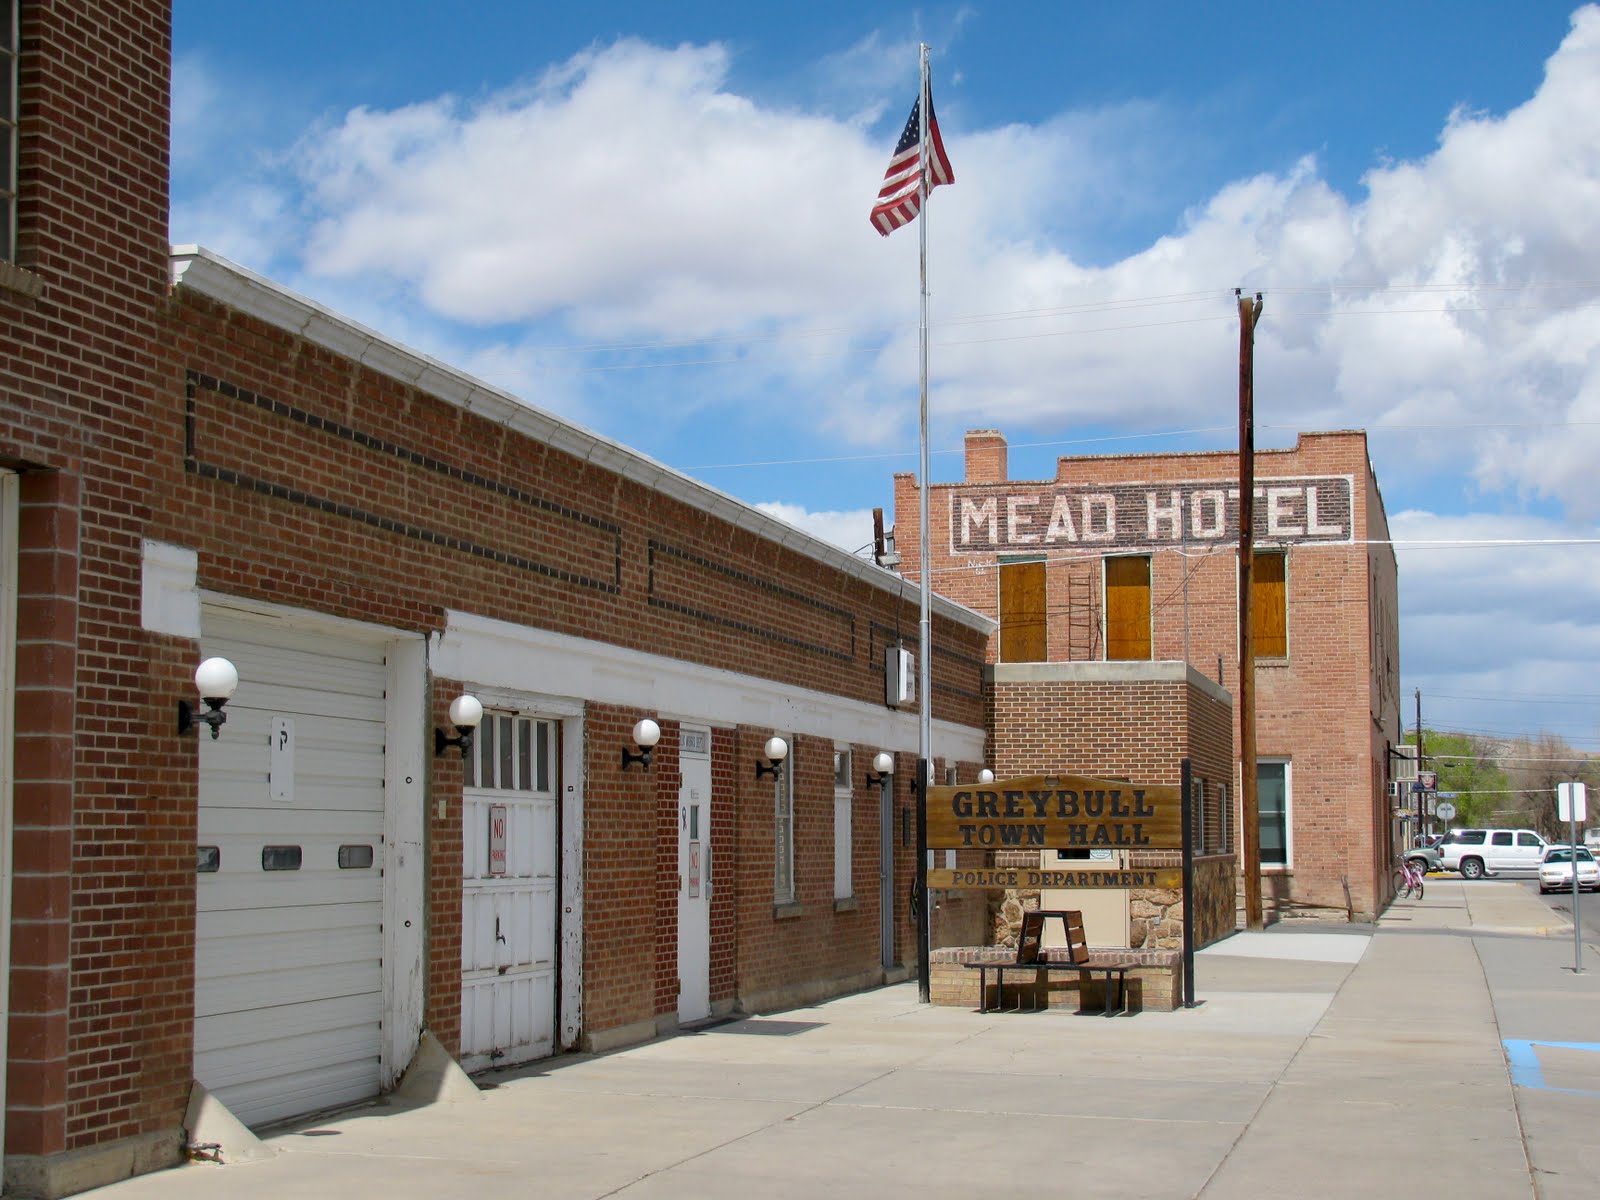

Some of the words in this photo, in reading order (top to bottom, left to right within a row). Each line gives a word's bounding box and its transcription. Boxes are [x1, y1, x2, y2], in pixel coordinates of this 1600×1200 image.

[960, 493, 1116, 545] MEAD
[952, 790, 1154, 818] GREYBULL
[493, 818, 504, 839] NO
[959, 824, 1046, 846] TOWN
[1068, 824, 1150, 846] HALL
[952, 871, 1018, 886] POLICE
[1028, 872, 1157, 886] DEPARTMENT
